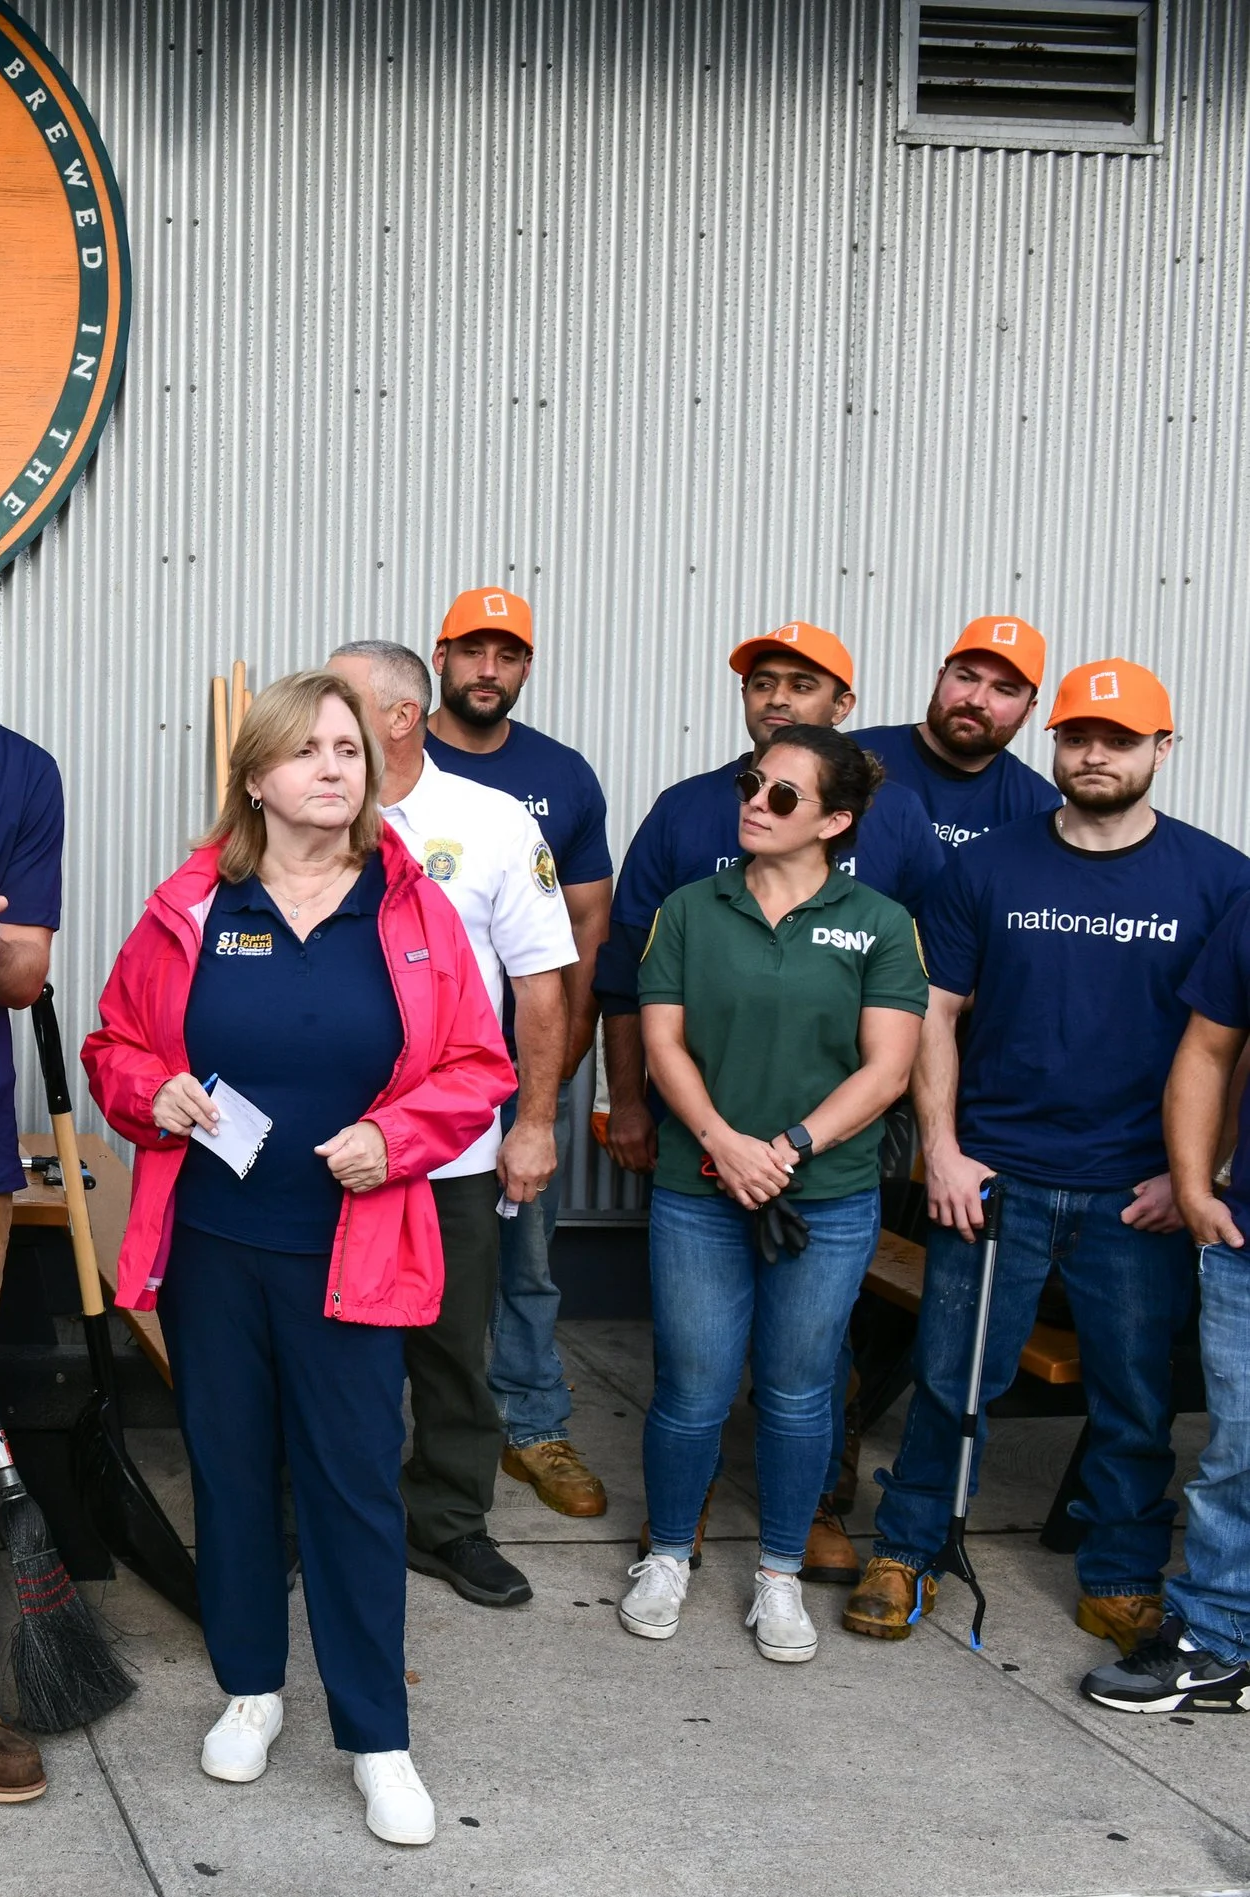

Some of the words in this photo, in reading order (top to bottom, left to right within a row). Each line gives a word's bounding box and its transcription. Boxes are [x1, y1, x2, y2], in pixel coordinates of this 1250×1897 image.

[4, 57, 103, 268] BREWED
[72, 323, 101, 381] IN
[3, 428, 71, 516] THE
[812, 927, 876, 954] DSNY
[1007, 908, 1178, 943] nationalgrid
